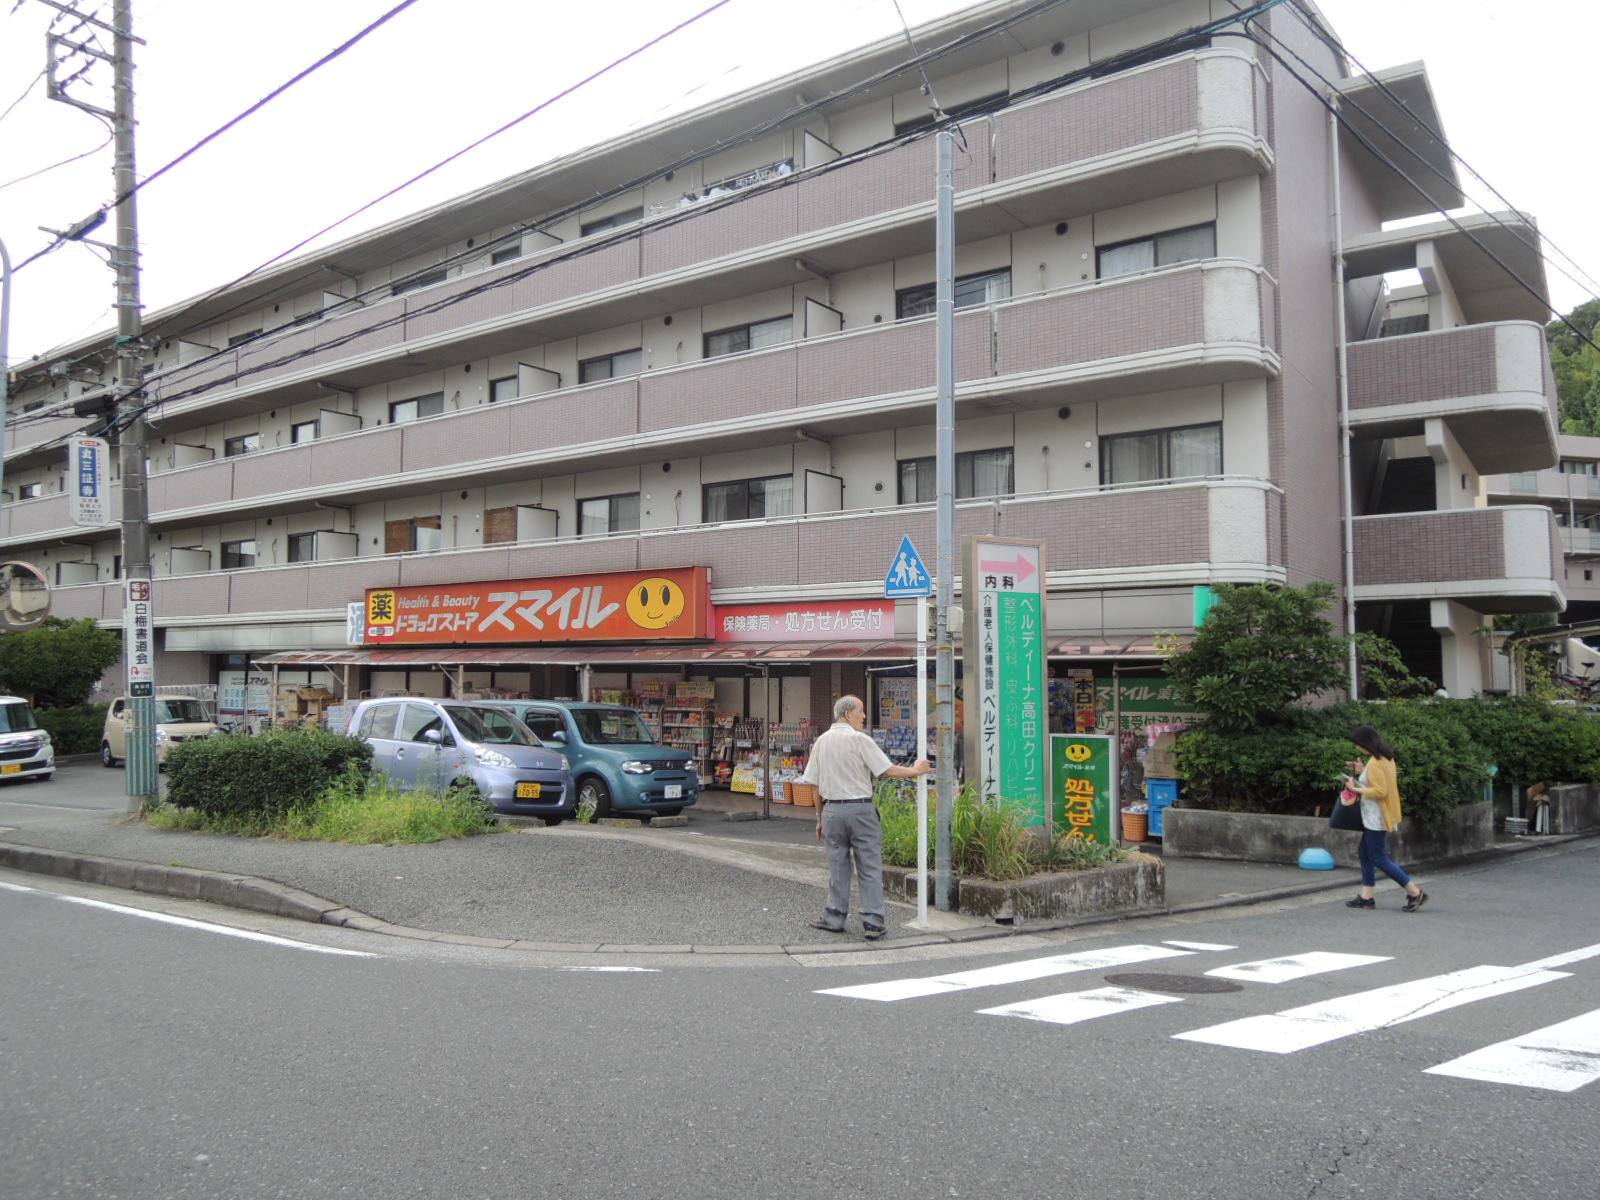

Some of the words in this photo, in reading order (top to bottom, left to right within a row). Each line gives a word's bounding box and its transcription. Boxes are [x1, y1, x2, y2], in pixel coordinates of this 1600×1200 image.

[81, 448, 94, 497] 丸三証券
[985, 575, 1014, 589] 内科
[371, 593, 392, 620] 薬
[398, 595, 428, 609] Health
[432, 594, 440, 607] &
[443, 594, 480, 610] Beauty
[478, 586, 620, 632] スマイル
[396, 612, 480, 633] ドラッグストア
[665, 614, 680, 627] Smile
[723, 608, 884, 633] 保険薬局・処方せん受付
[135, 603, 148, 665] 白梅書道会
[1075, 678, 1092, 704] 本日
